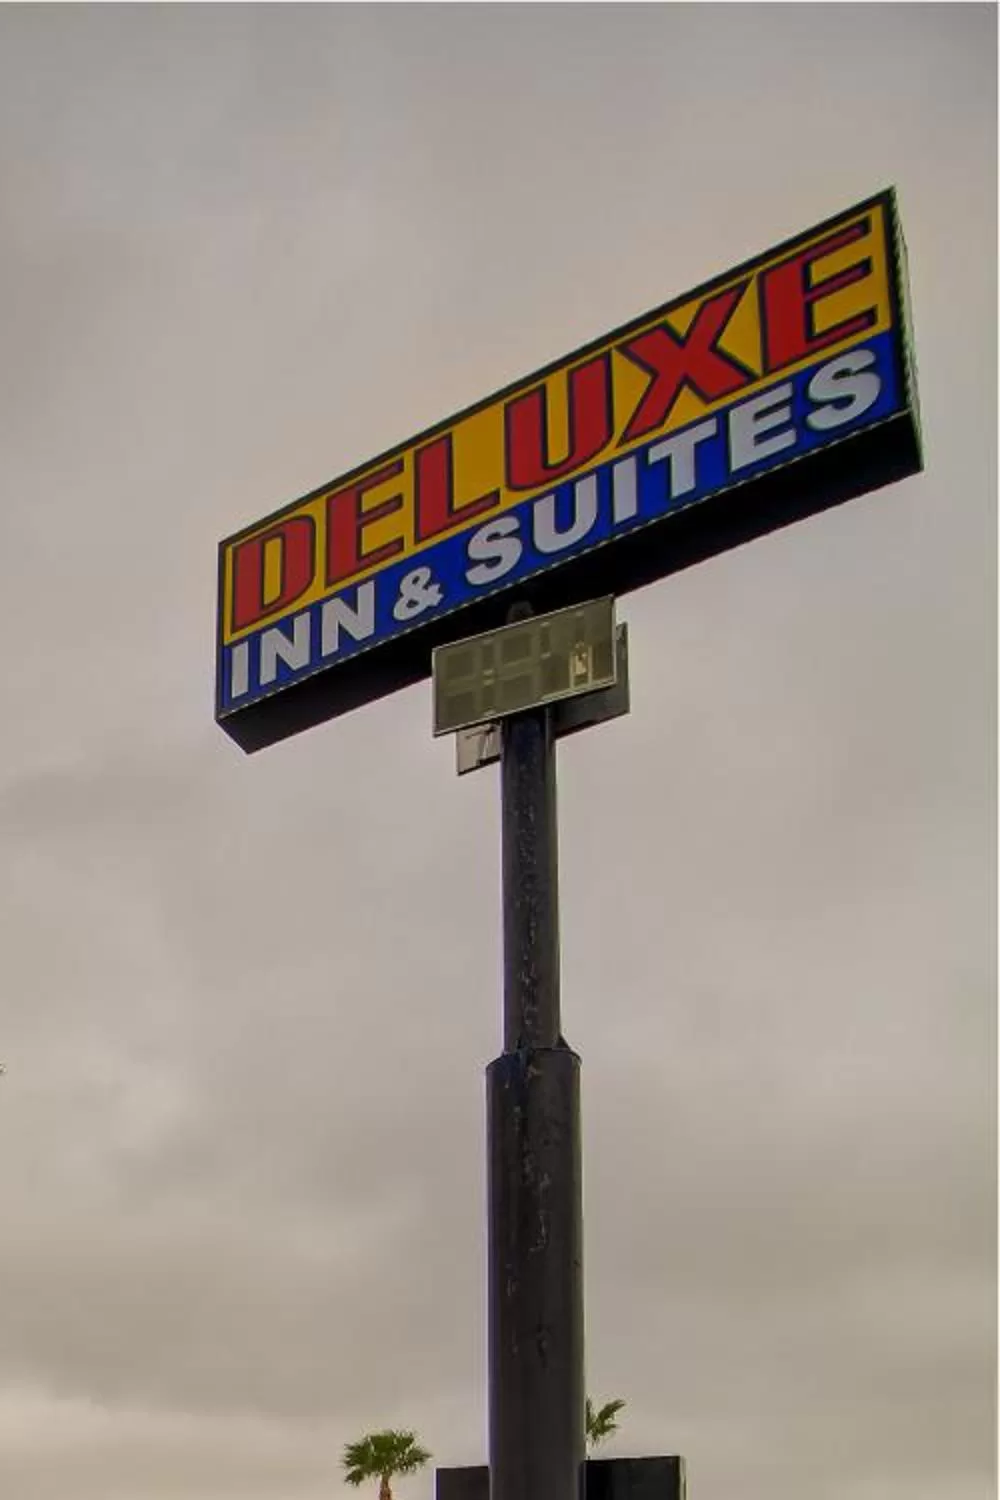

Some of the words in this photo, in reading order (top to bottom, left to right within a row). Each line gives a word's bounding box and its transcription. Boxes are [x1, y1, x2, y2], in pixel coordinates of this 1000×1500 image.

[229, 214, 878, 637] DELUXE
[230, 579, 376, 701] INN
[392, 566, 443, 622] &
[466, 348, 882, 586] SUITES
